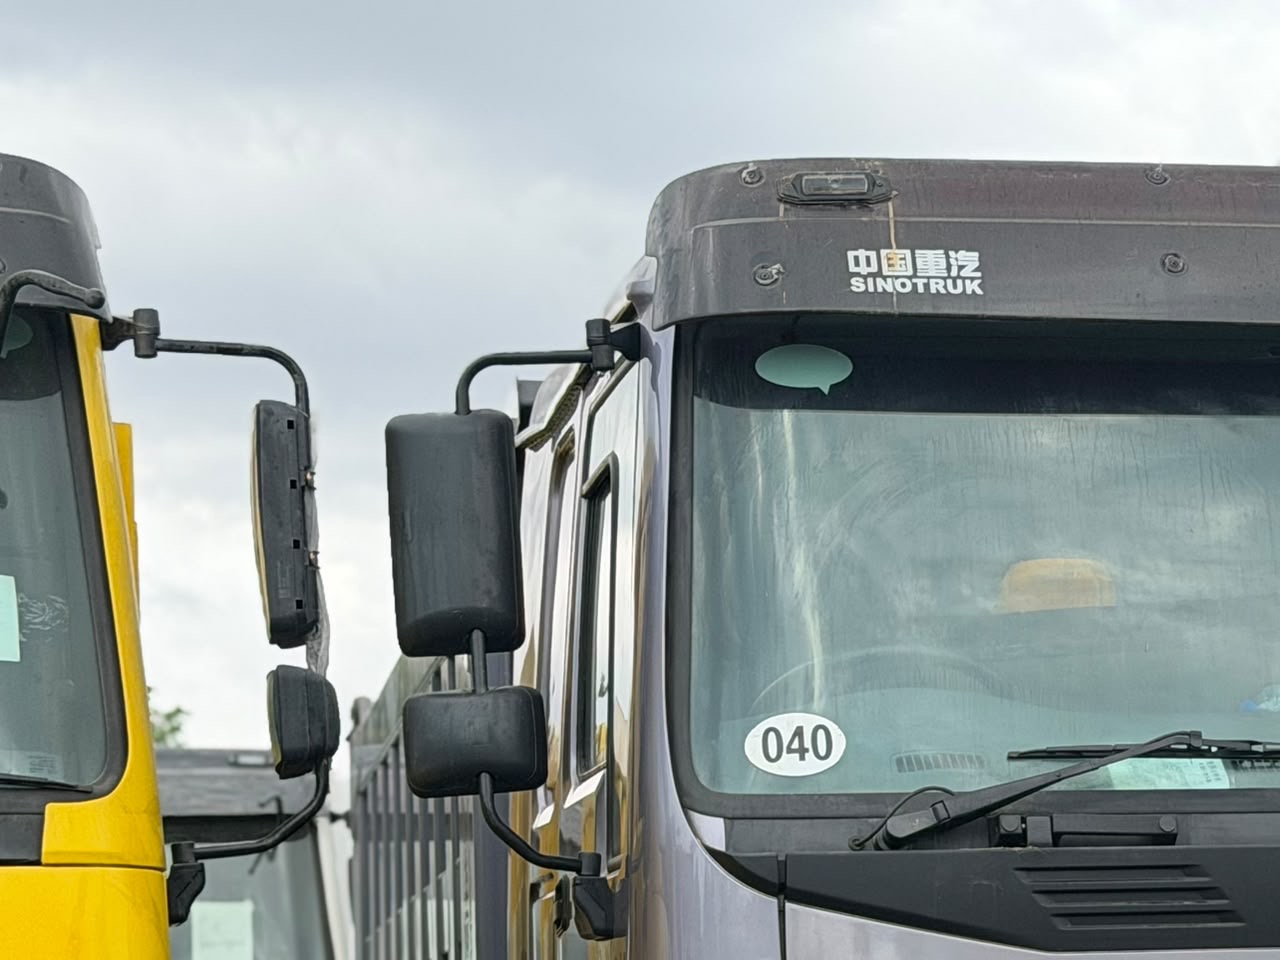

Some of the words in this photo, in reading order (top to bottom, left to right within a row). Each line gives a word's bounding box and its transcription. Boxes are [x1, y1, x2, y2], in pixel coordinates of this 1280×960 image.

[847, 249, 982, 277] 中国重汽
[850, 276, 984, 295] SINOTRUK
[761, 723, 833, 763] 040
